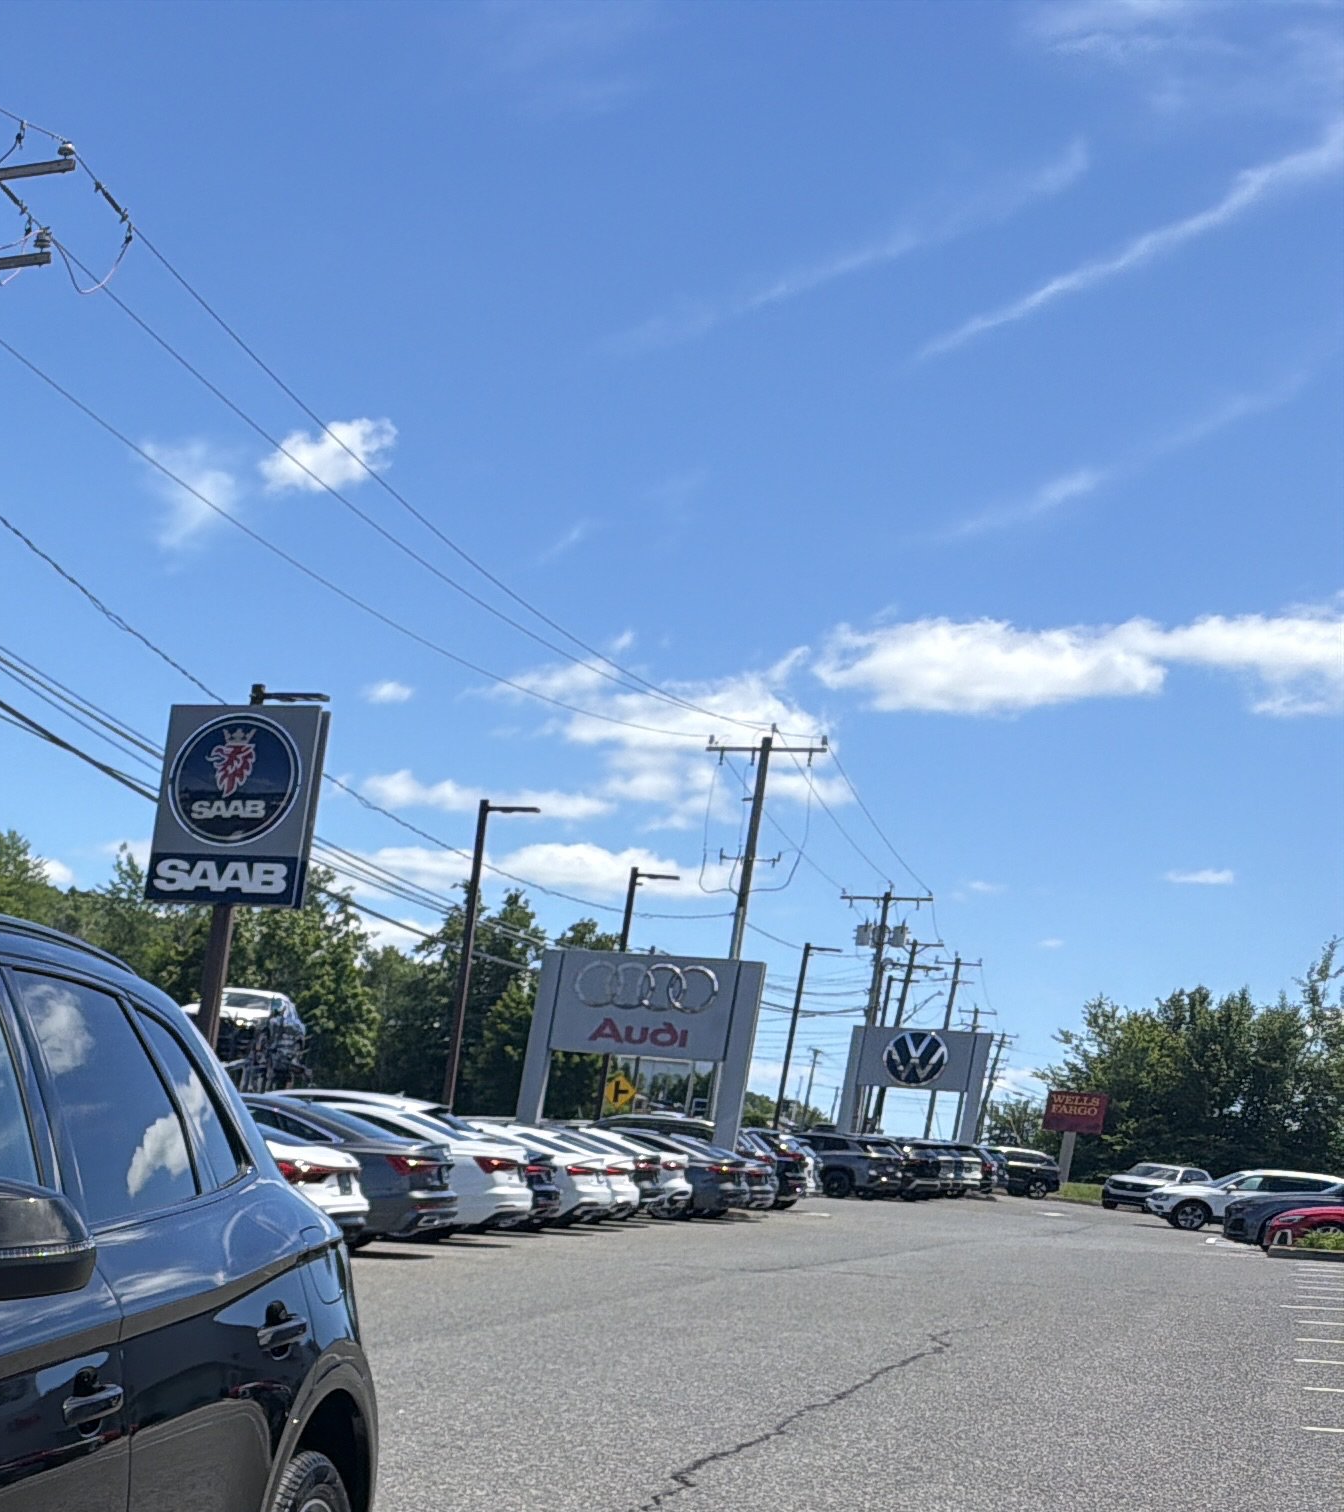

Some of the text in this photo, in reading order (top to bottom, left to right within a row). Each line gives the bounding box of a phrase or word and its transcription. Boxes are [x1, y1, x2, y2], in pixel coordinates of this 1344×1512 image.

[190, 800, 266, 819] SAAB
[152, 858, 288, 894] SAAB
[588, 1017, 689, 1048] Audi
[1051, 1094, 1101, 1107] WELLS
[1051, 1104, 1098, 1116] FARGO
